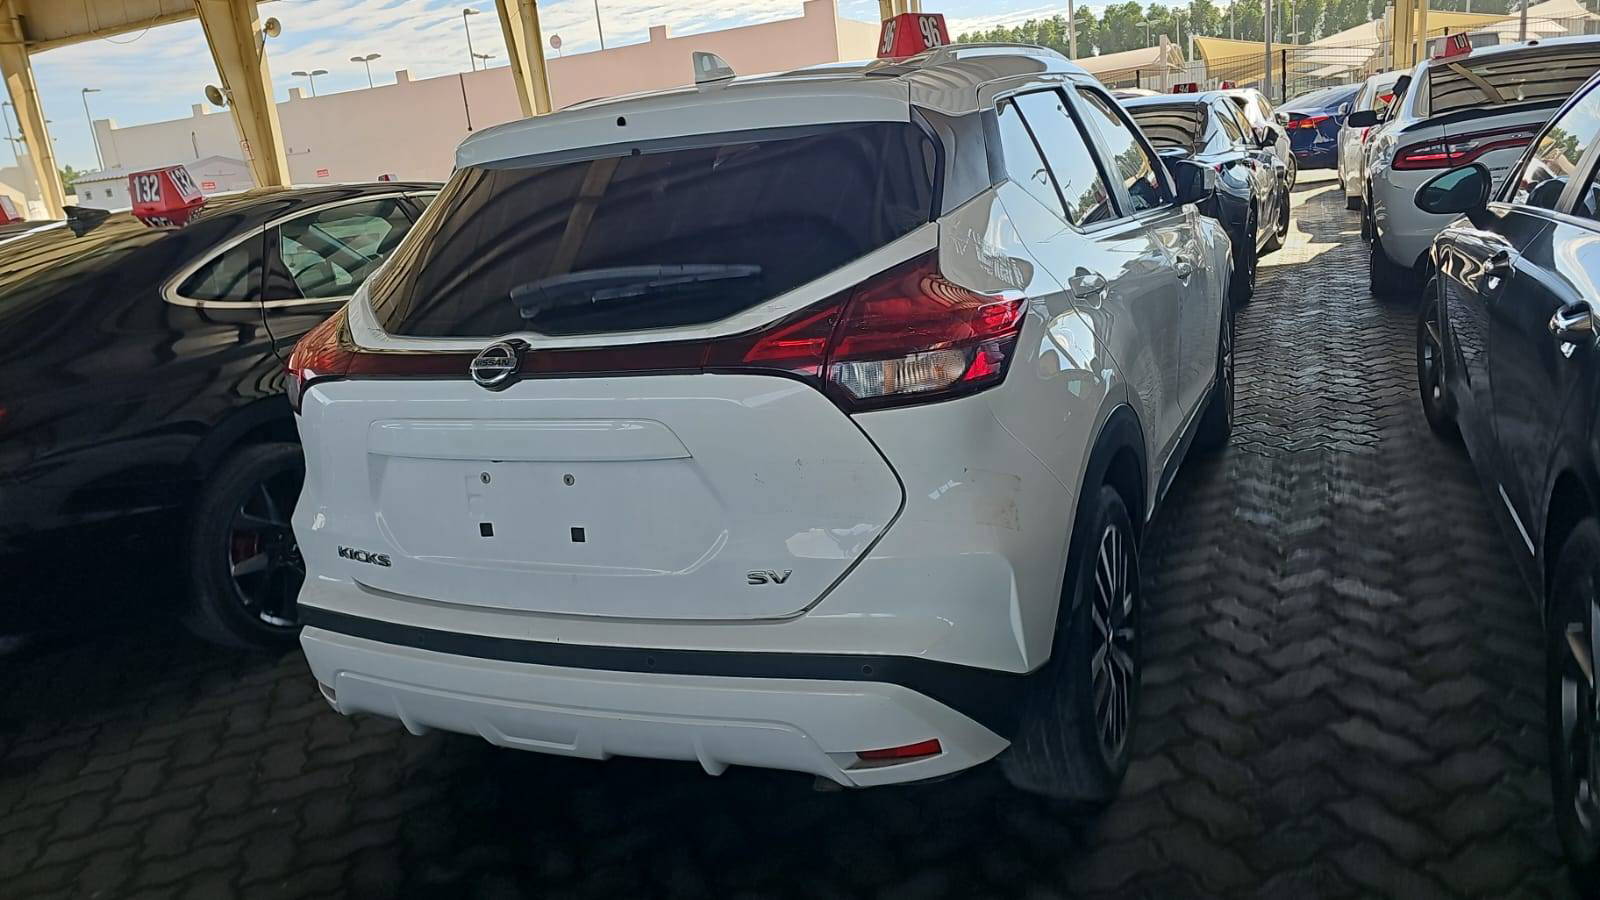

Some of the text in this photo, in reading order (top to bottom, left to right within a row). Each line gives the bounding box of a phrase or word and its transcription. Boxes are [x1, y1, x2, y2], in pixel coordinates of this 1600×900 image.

[882, 20, 896, 53] 96
[919, 16, 942, 47] 96
[1454, 33, 1468, 49] 101
[133, 175, 160, 203] 132
[474, 358, 510, 367] NISSAN
[338, 545, 392, 567] KICKS
[747, 570, 792, 585] SV
